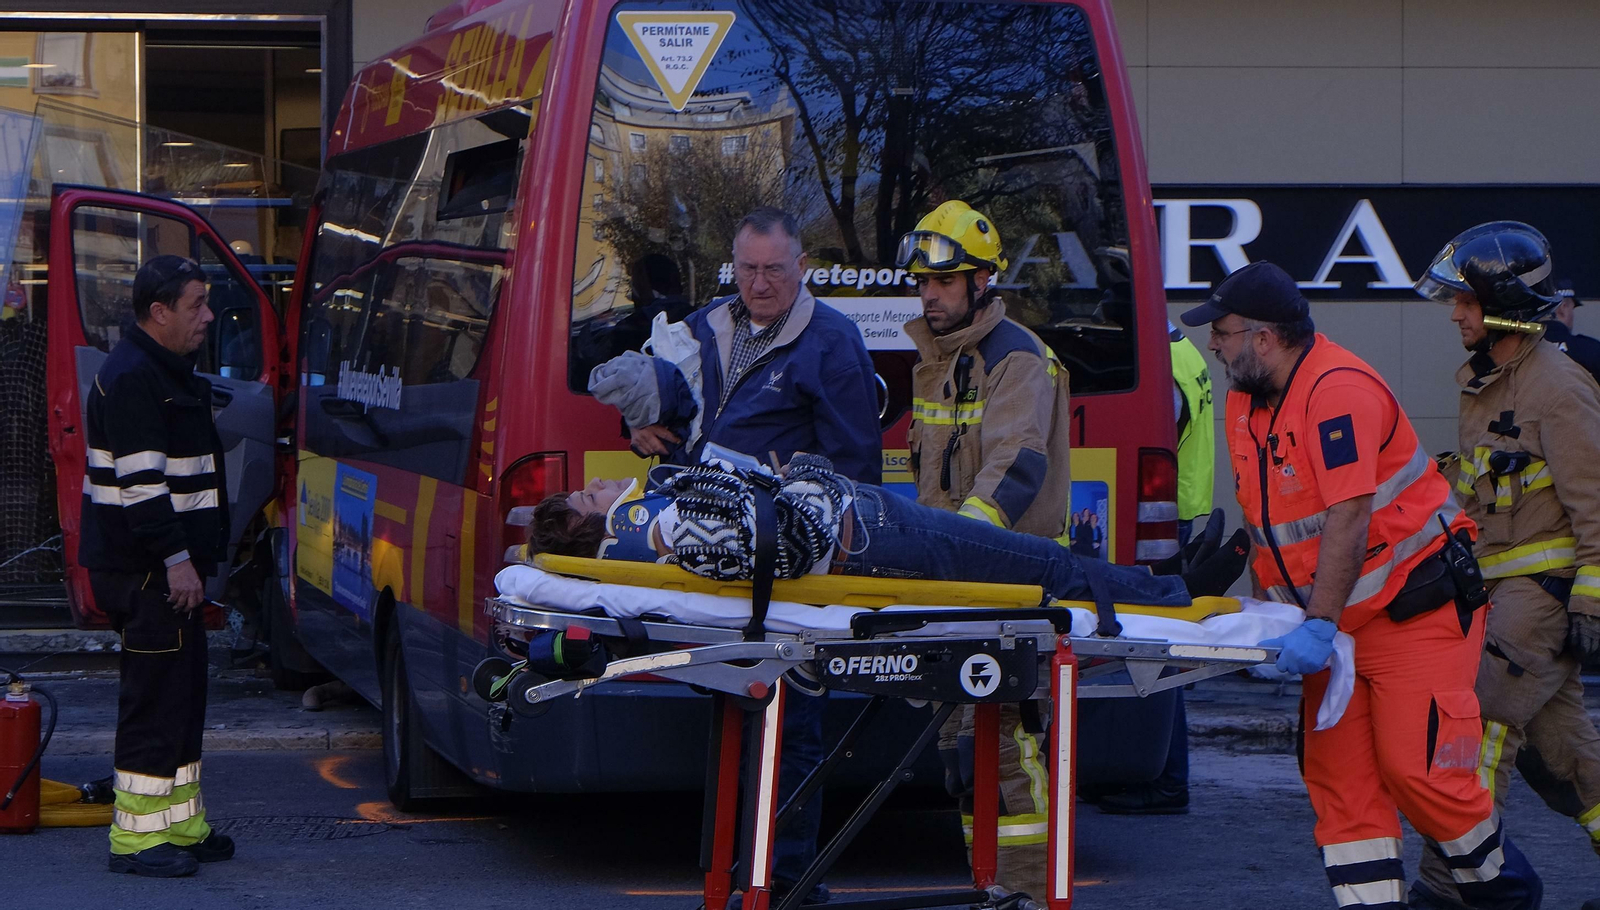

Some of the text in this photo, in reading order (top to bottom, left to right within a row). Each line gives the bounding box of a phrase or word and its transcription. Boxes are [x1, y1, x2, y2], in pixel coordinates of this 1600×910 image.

[641, 24, 710, 36] PERMÍTAME
[659, 38, 693, 47] SALIR
[864, 328, 899, 338] Sevilla
[846, 653, 919, 675] FERNO
